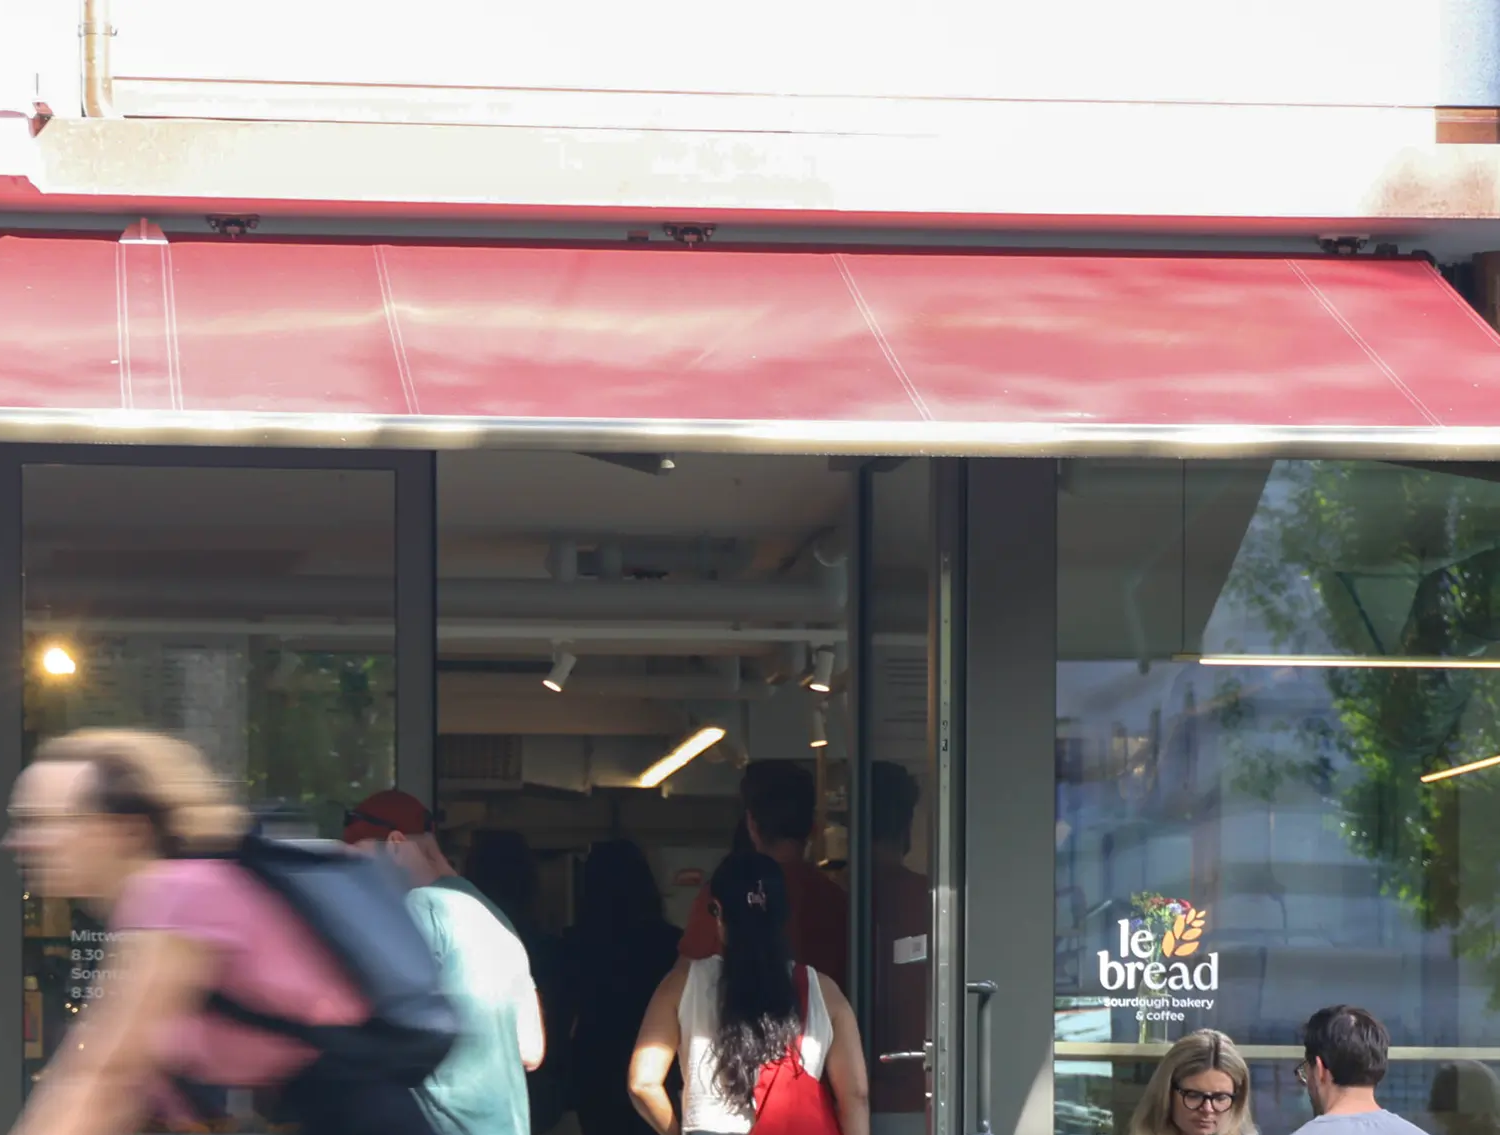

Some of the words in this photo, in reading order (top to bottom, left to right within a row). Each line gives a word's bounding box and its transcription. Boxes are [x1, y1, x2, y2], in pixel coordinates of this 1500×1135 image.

[1117, 918, 1155, 958] le
[71, 948, 105, 961] 8.30
[71, 967, 123, 980] Sonnt
[1097, 950, 1219, 991] bread
[71, 986, 105, 999] 8.30
[1172, 997, 1214, 1010] bakery
[1135, 1010, 1144, 1021] &
[1146, 1010, 1185, 1021] coffee
